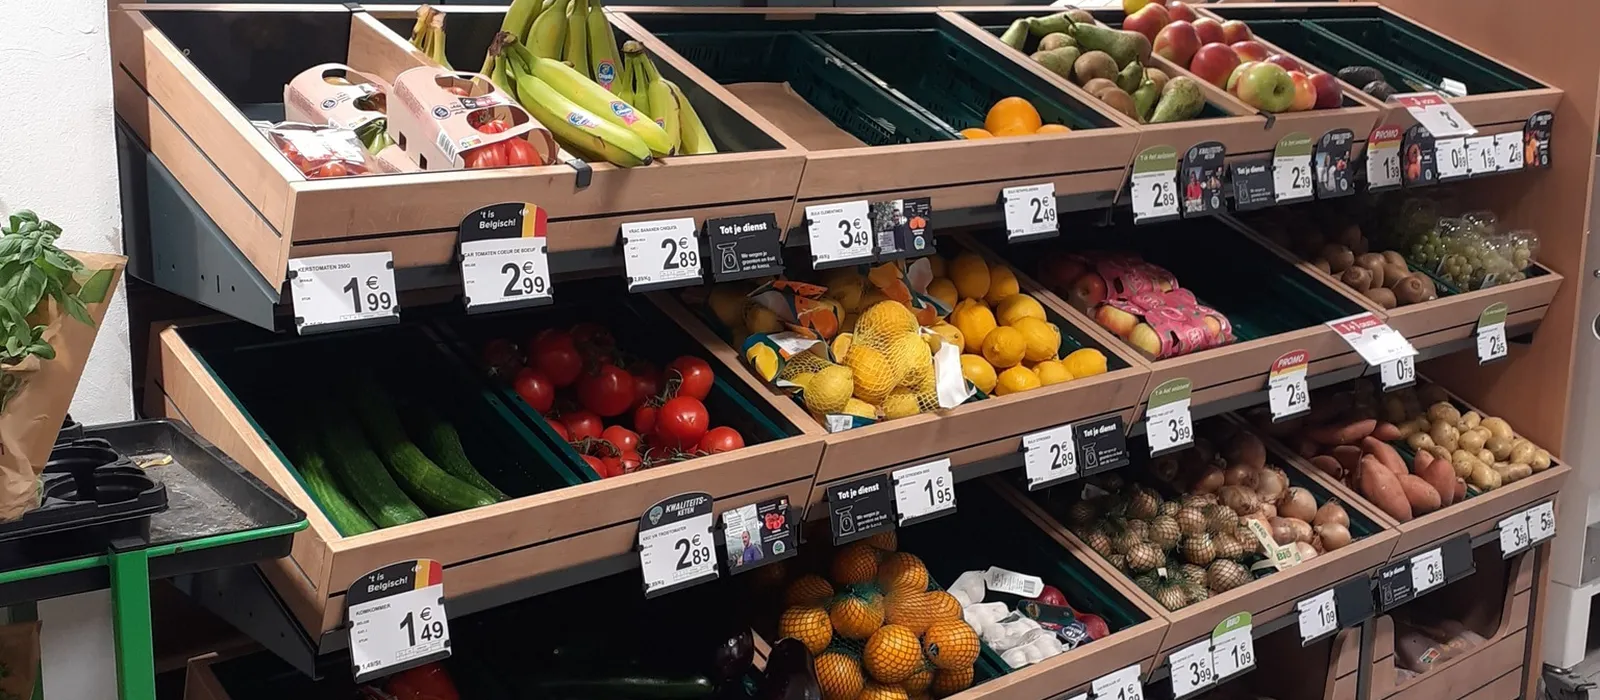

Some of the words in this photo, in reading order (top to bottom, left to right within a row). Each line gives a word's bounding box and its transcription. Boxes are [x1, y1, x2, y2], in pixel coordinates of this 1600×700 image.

[1375, 129, 1399, 139] PROMO
[1383, 157, 1390, 179] 1
[1481, 148, 1487, 169] 1
[1292, 167, 1300, 189] 2
[1152, 183, 1163, 207] 2
[1030, 197, 1043, 224] 2
[479, 218, 516, 230] Belgisch!
[719, 225, 733, 235] Tot
[734, 224, 742, 236] je
[742, 222, 767, 233] dienst
[838, 219, 854, 249] 3
[854, 231, 869, 246] 49
[661, 238, 679, 270] 2
[679, 251, 697, 268] 89
[298, 264, 337, 272] KERSTOMATEN
[501, 262, 523, 297] 2
[523, 276, 545, 294] 99
[343, 277, 362, 313] 1
[367, 292, 391, 312] 99
[1490, 335, 1497, 356] 2
[1278, 353, 1304, 367] PROMO
[1397, 360, 1404, 380] 0
[1287, 384, 1296, 407] 2
[1093, 428, 1099, 437] je
[1099, 423, 1116, 434] dienst
[1169, 419, 1179, 443] 3
[1050, 444, 1062, 470] 2
[837, 491, 850, 500] Tot
[850, 489, 858, 499] je
[858, 483, 880, 495] dienst
[924, 479, 934, 506] 1
[937, 487, 951, 503] 95
[665, 496, 708, 514] KWALITEITS-
[677, 508, 695, 517] KETEN
[675, 538, 692, 571] 2
[692, 547, 710, 565] 89
[367, 576, 408, 593] Belgisch!
[1427, 563, 1434, 584] 3
[355, 603, 391, 616] KOMKOMMER
[1318, 604, 1325, 627] 1
[400, 611, 416, 647] 1
[421, 621, 444, 641] 49
[1226, 615, 1240, 628] BIO
[1231, 645, 1239, 668] 1
[1189, 662, 1200, 686] 3
